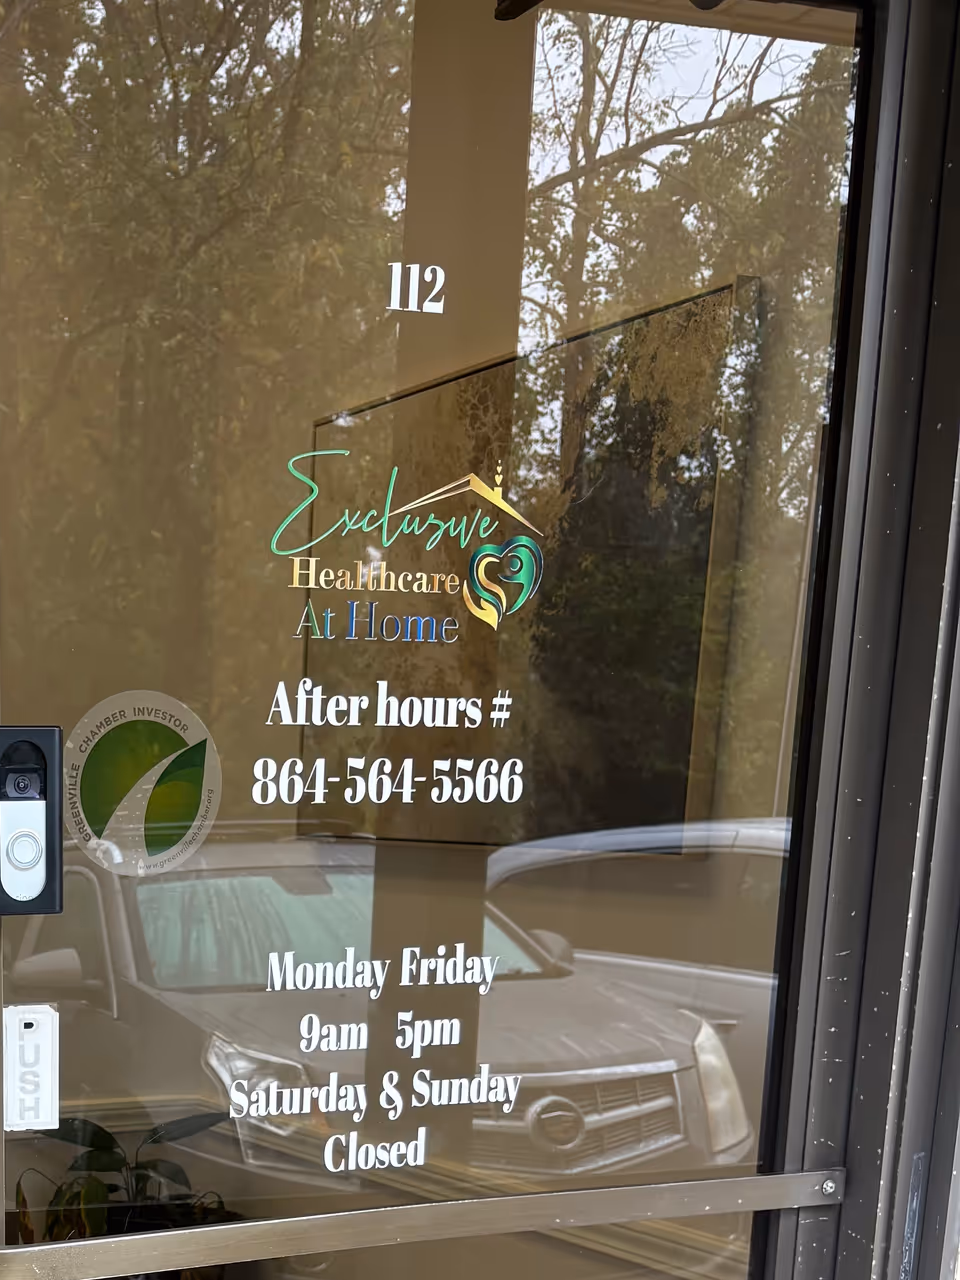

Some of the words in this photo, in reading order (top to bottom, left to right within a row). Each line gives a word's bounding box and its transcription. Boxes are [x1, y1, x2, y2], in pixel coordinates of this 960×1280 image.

[385, 261, 446, 315] 112
[271, 449, 499, 556] Exclusive
[287, 556, 461, 594] Healthcare
[292, 598, 336, 640] At
[344, 600, 460, 643] Home
[133, 706, 189, 735] INVESTOR
[266, 676, 369, 727] After
[375, 679, 482, 729] hours
[490, 689, 513, 728] #
[79, 709, 127, 754] CHAMBER
[68, 762, 91, 843] GREENVILLE
[251, 757, 524, 805] 864-564-5566
[265, 947, 391, 1000] Monday
[398, 943, 500, 995] Friday
[299, 1013, 369, 1053] 9am
[395, 1010, 461, 1059] 5pm
[18, 1017, 41, 1121] PUSH
[229, 1071, 367, 1123] Saturday
[379, 1070, 403, 1121] &
[411, 1064, 523, 1113] Sunday
[323, 1127, 428, 1173] Closed
